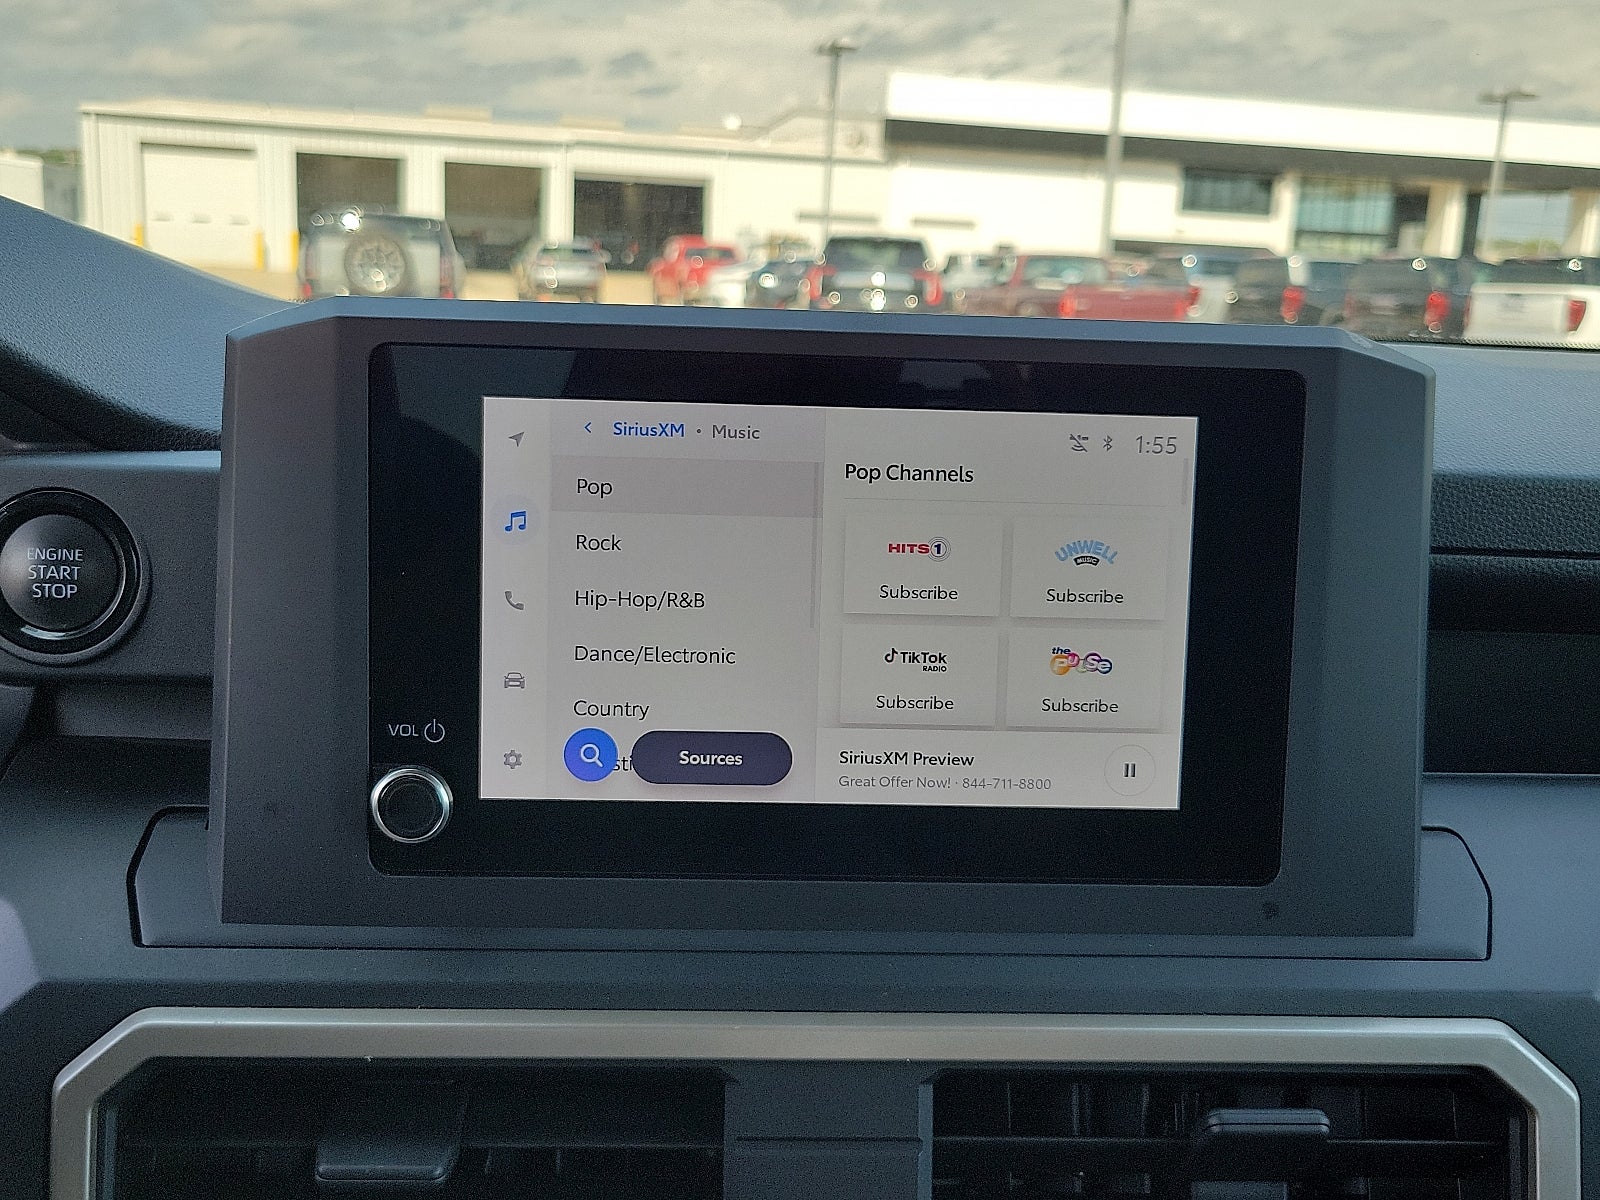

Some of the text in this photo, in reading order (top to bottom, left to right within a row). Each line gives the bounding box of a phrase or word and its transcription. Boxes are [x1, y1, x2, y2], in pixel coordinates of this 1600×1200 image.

[613, 421, 761, 440] SiriusXM Music
[1135, 435, 1177, 455] 1:55
[844, 463, 974, 484] Pop Channels
[577, 478, 613, 499] Pop
[576, 534, 622, 551] Rock
[27, 548, 84, 562] ENGINE
[1054, 540, 1118, 564] UNWELL
[1076, 556, 1098, 564] MUSIC
[28, 565, 82, 581] START
[32, 583, 78, 599] STOP
[879, 584, 959, 601] Subscribe
[1045, 588, 1124, 604] Subscribe
[575, 589, 705, 612] Hip-Hop/R&B
[574, 645, 736, 666] Dance/Electronic
[899, 651, 948, 665] TikTok
[1051, 646, 1071, 655] the
[573, 699, 650, 721] Country
[875, 694, 955, 710] Subscribe
[1041, 698, 1119, 713] Subscribe
[387, 723, 419, 737] VOL
[678, 750, 743, 766] Sources
[839, 750, 975, 767] SiriusXM Preview
[838, 775, 1052, 790] Great Offer Now! 844-711-8800
